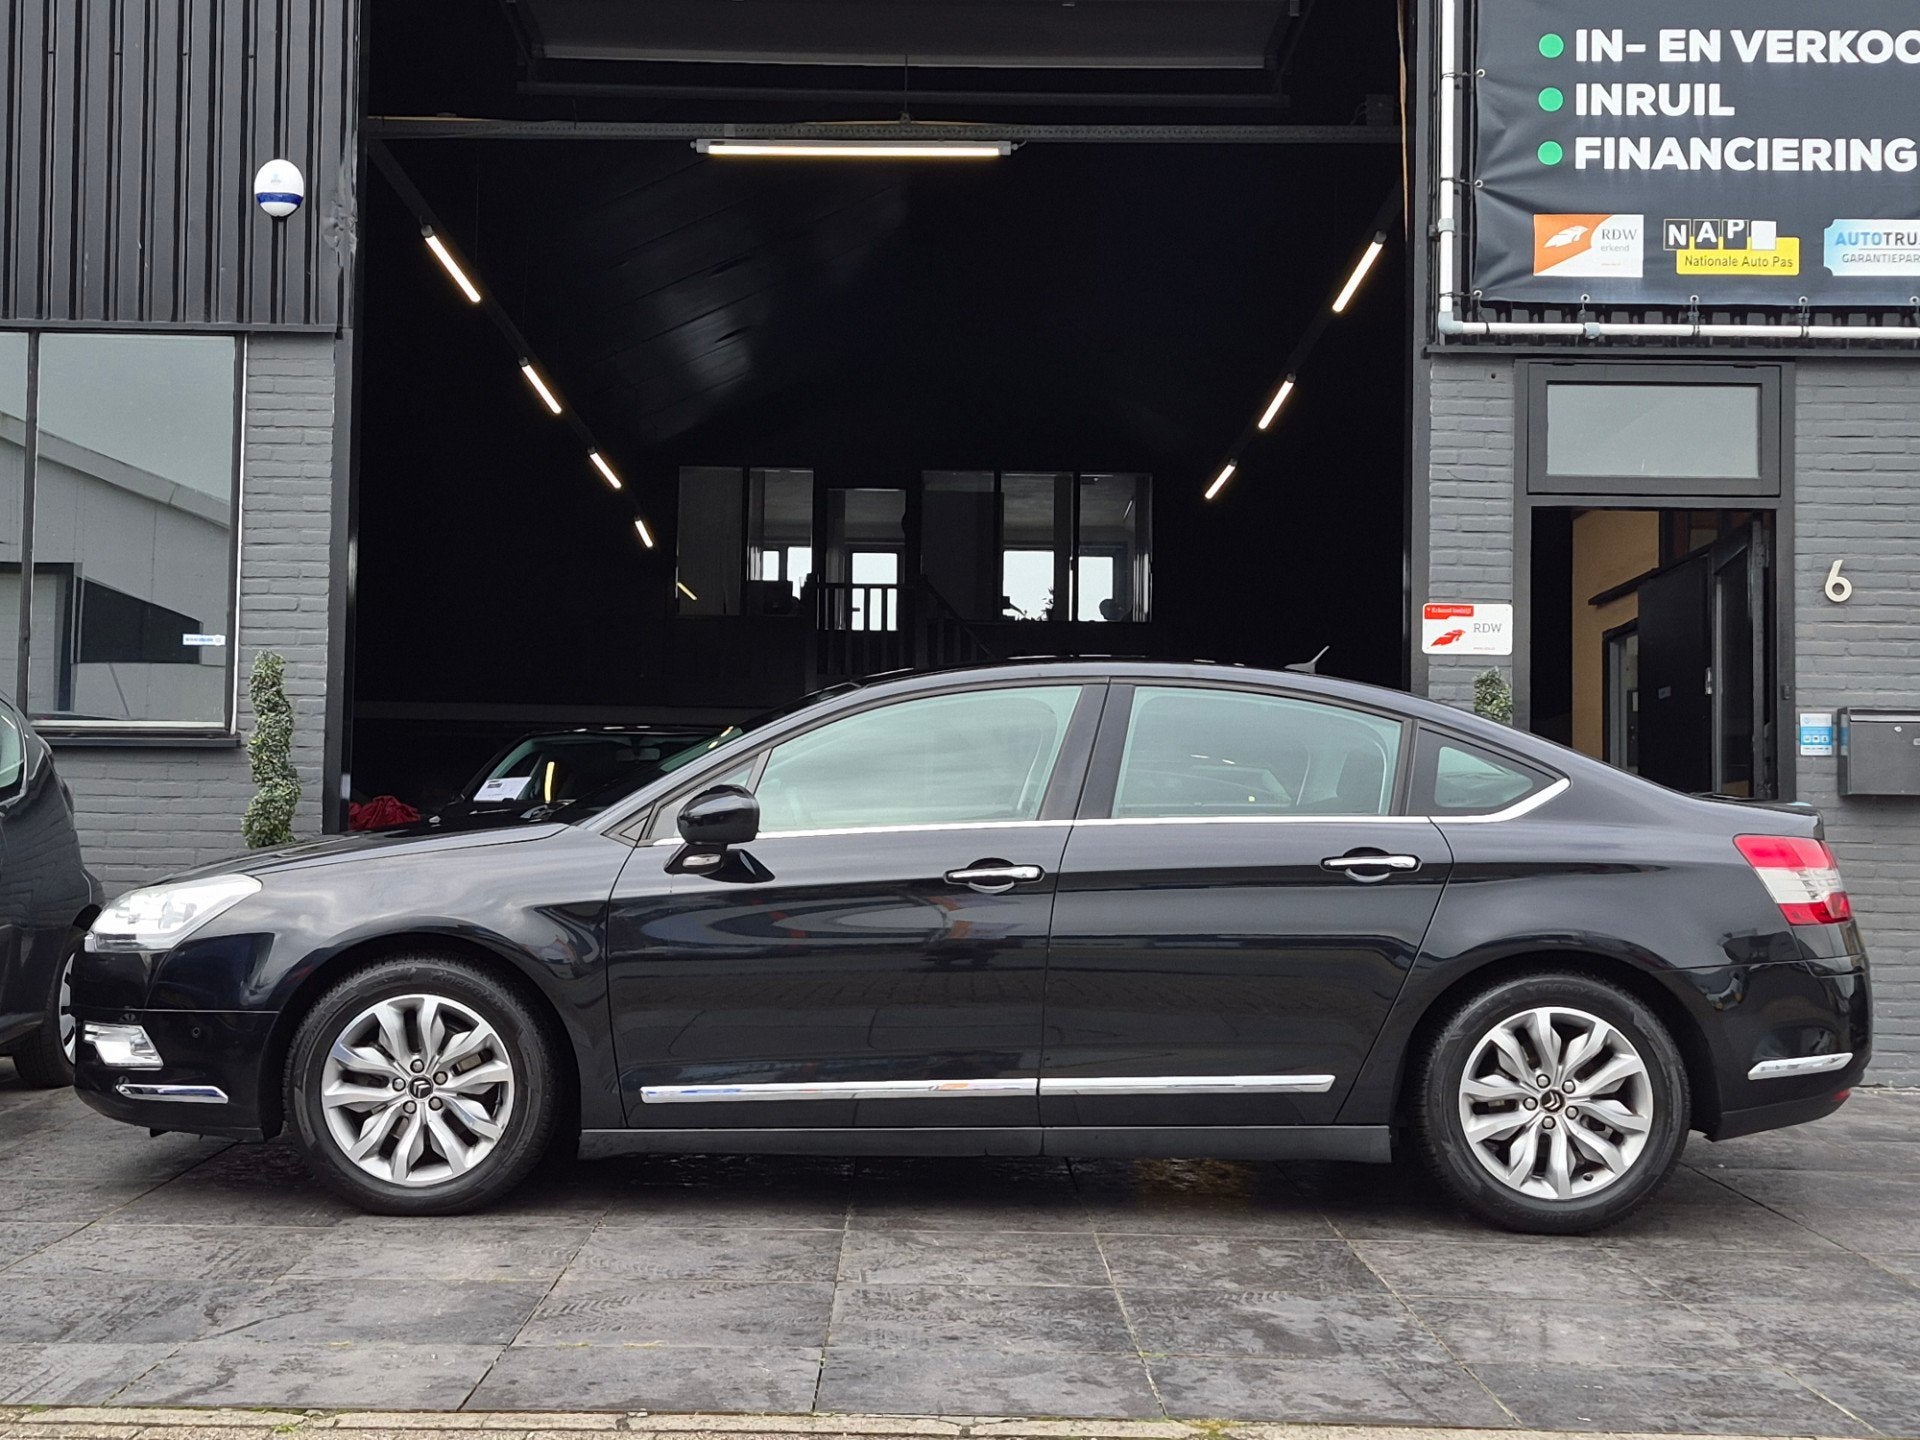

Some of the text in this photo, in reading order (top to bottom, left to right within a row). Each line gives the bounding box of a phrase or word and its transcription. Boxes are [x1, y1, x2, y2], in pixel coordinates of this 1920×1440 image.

[1575, 28, 1920, 64] IN- EN VERKOO
[1575, 83, 1735, 117] INRUIL
[1575, 136, 1918, 173] FINANCIERING
[1601, 228, 1638, 241] RDW
[1668, 220, 1745, 246] NAP
[1835, 231, 1920, 246] AUTOTRU
[1600, 243, 1630, 252] erkend
[1684, 255, 1794, 268] Nationale Auto Pas
[1825, 559, 1852, 602] 6
[1473, 622, 1502, 634] RDW
